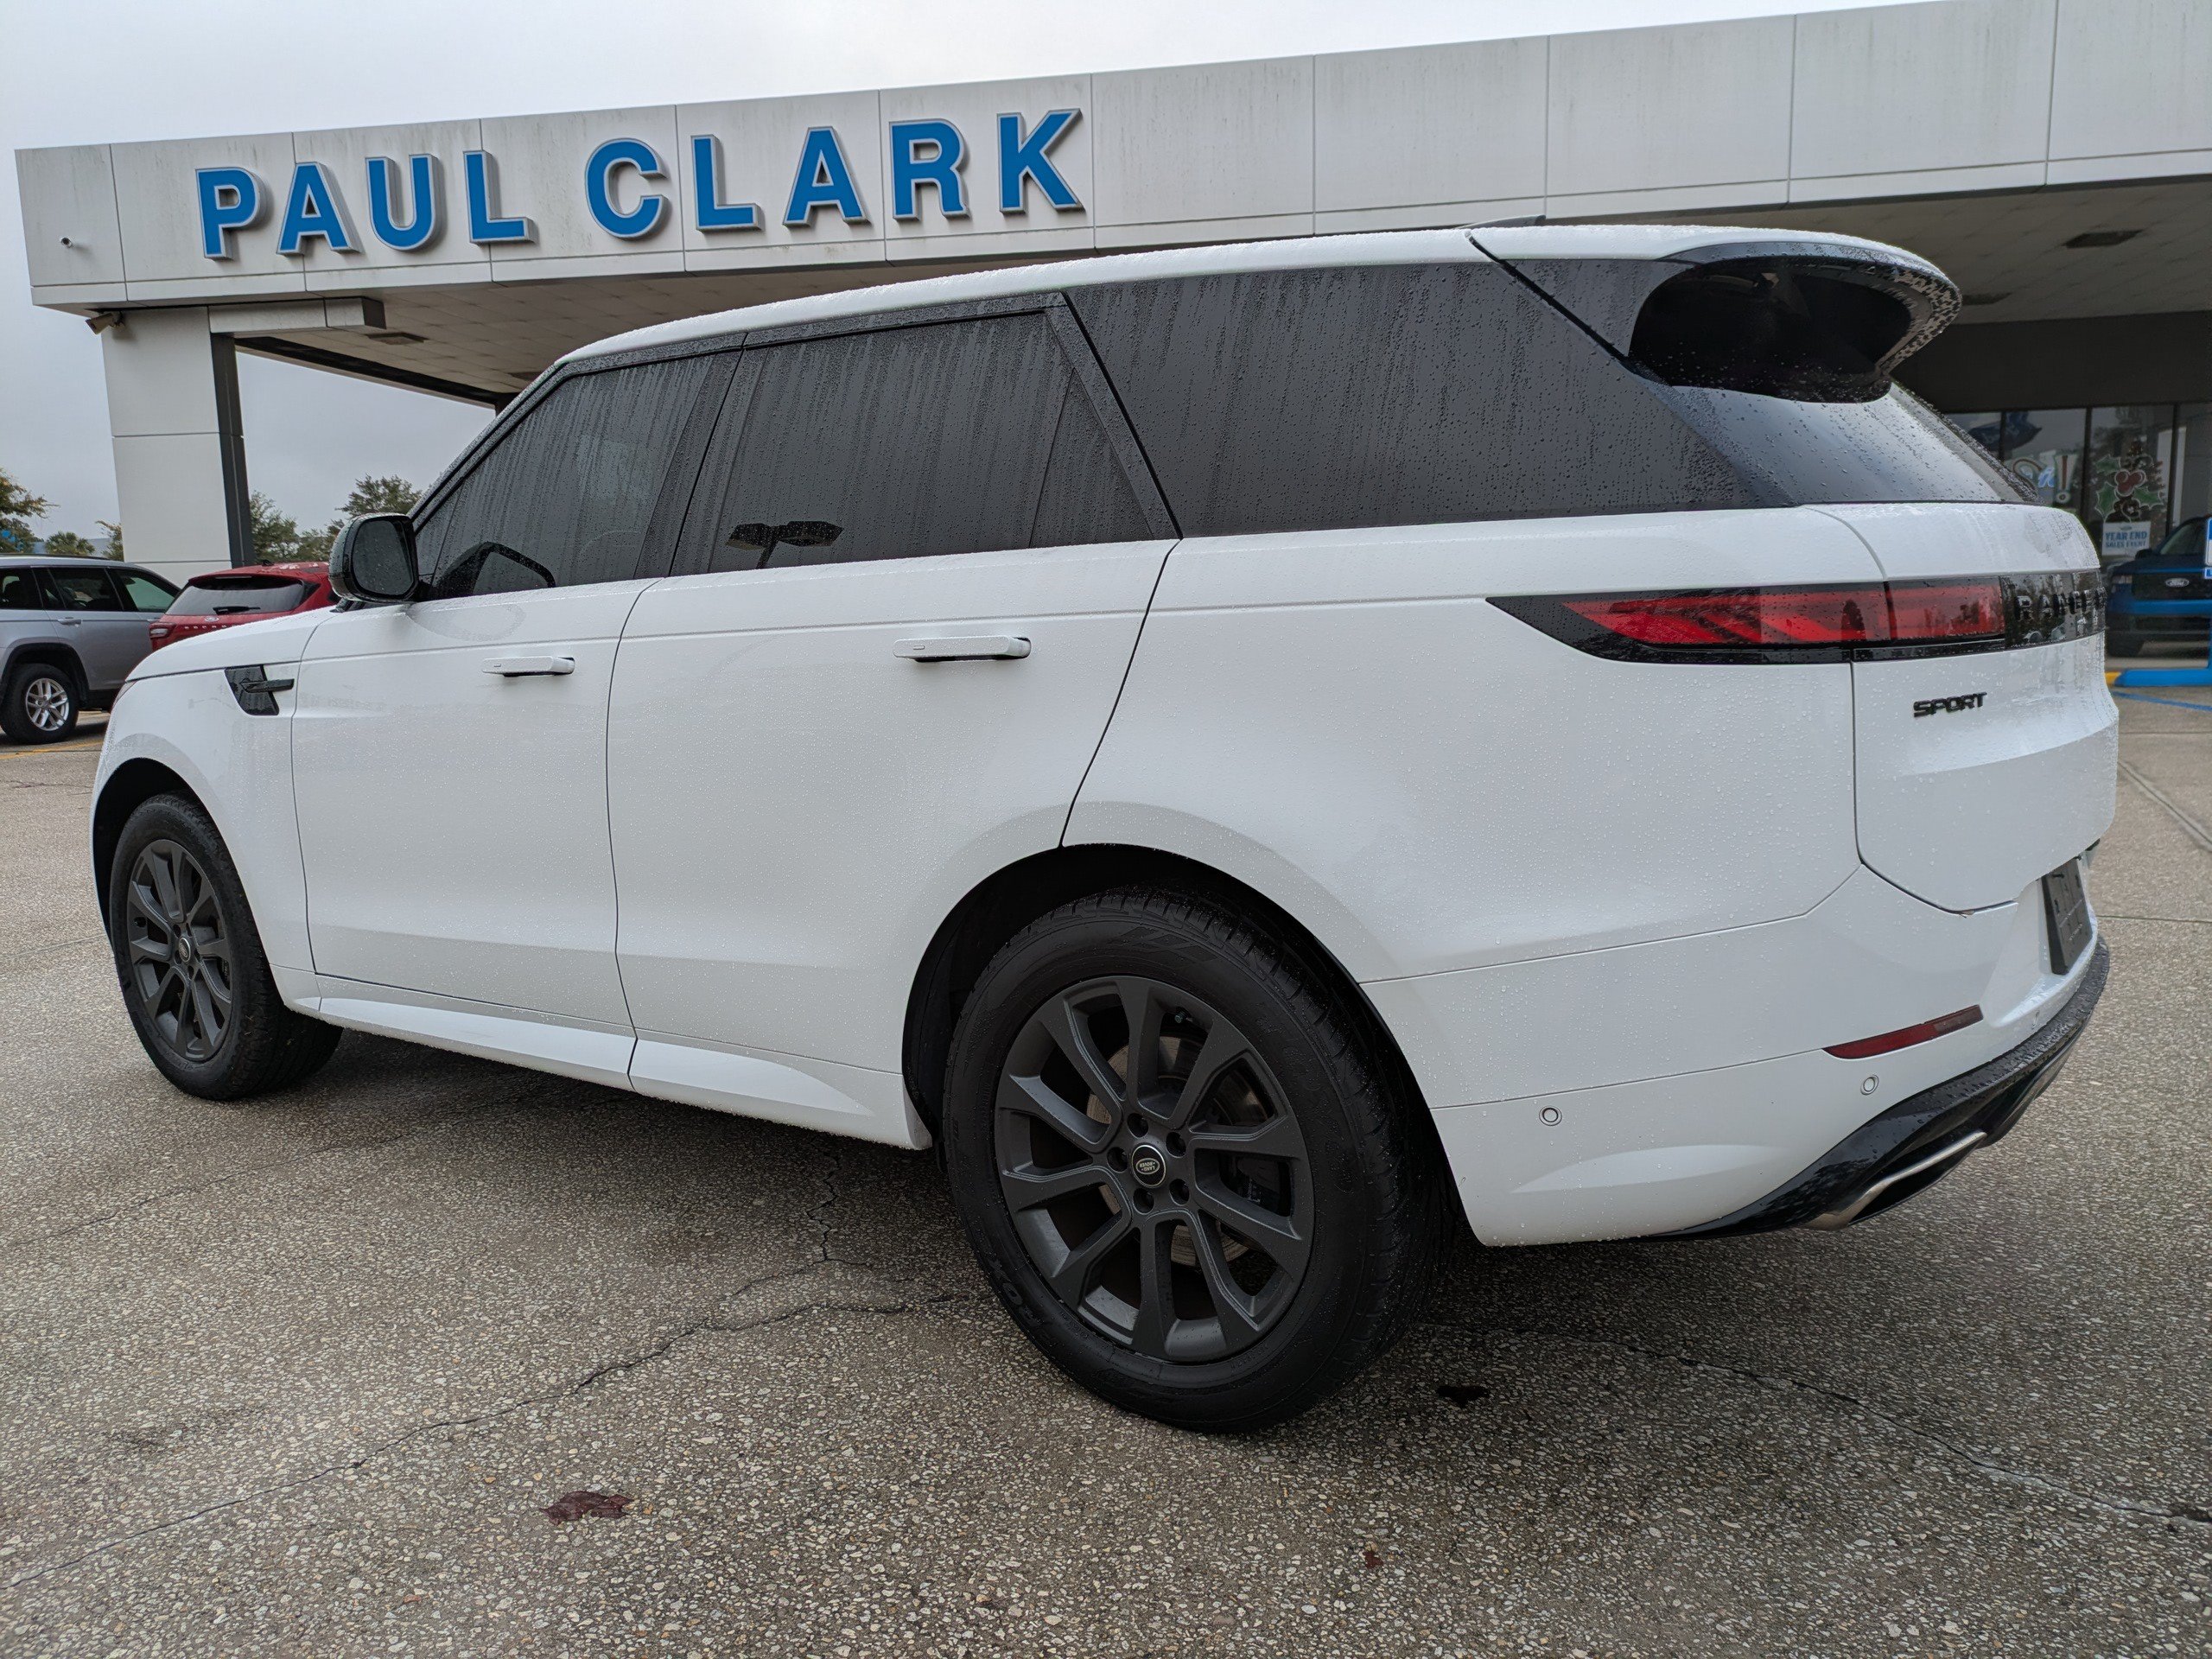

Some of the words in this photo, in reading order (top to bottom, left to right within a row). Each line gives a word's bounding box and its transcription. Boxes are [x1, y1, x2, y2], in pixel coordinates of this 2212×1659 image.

[195, 149, 532, 258] PAUL
[585, 108, 1084, 241] CLARK
[2105, 531, 2128, 540] YEAR
[2129, 531, 2148, 539] END
[1913, 691, 1987, 717] SPORT
